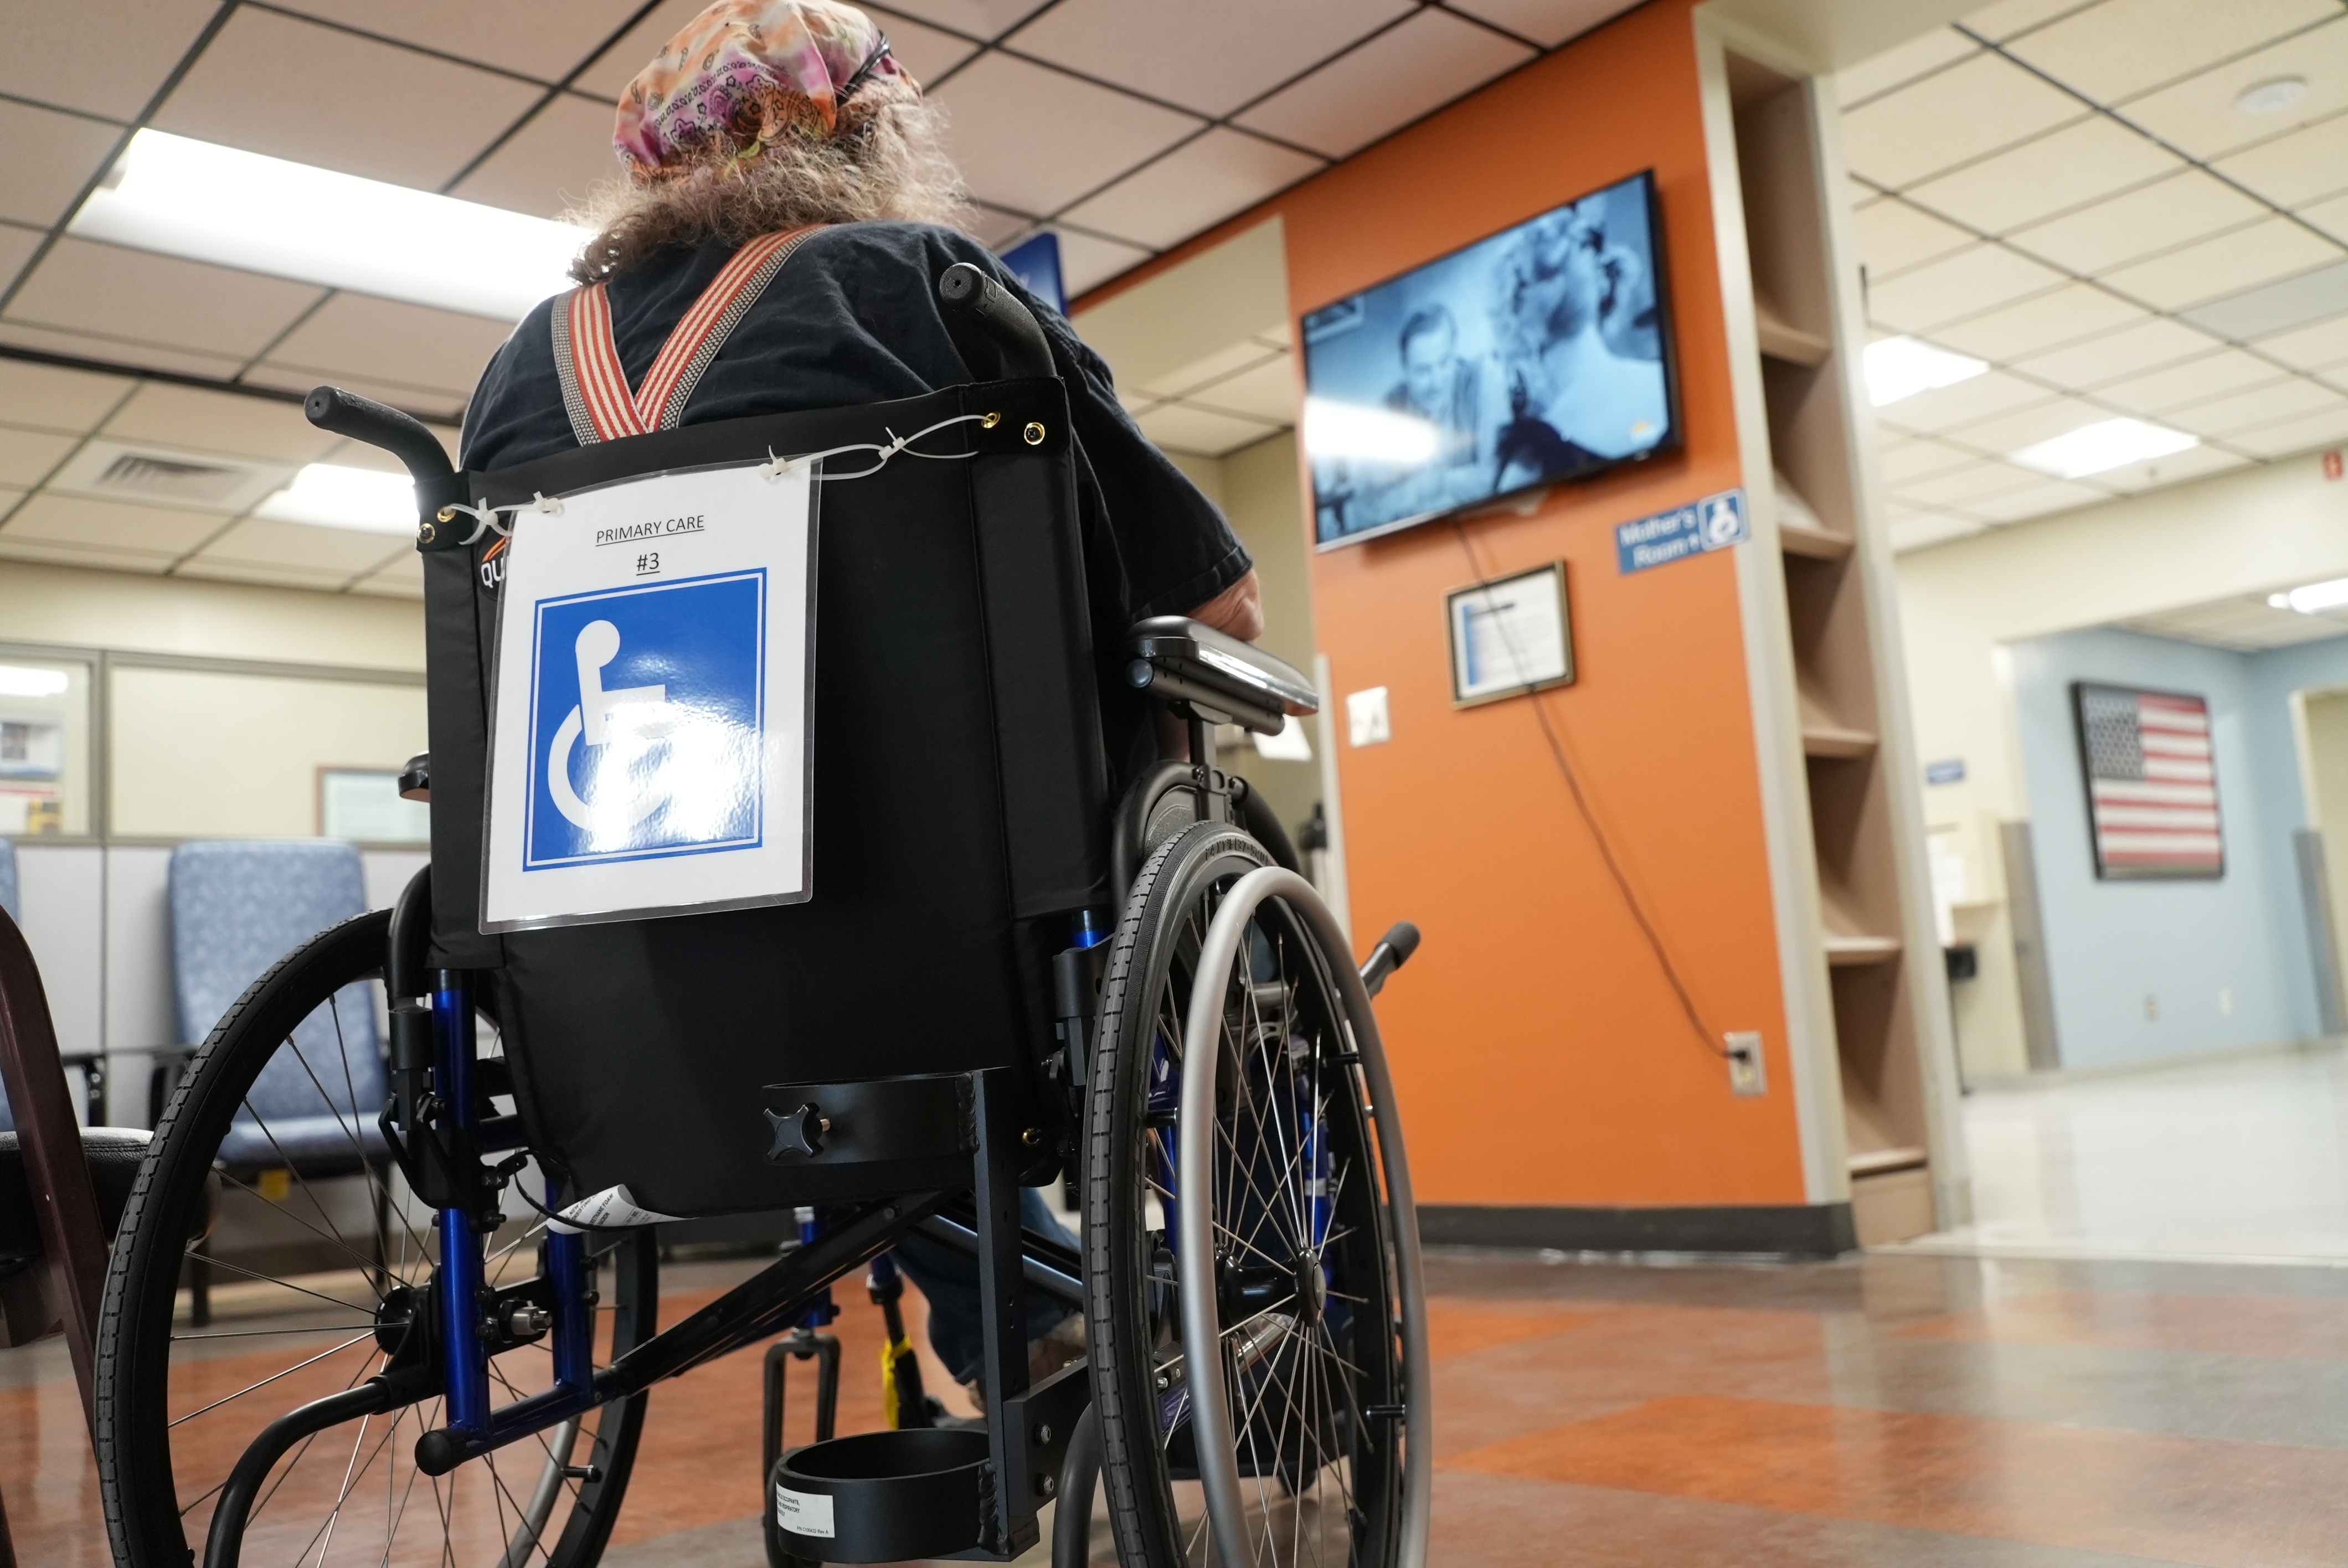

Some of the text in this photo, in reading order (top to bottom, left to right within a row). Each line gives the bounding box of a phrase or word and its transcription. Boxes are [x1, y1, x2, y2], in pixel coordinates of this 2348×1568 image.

[596, 515, 704, 543] PRIMARY CARE
[636, 552, 660, 571] #3
[571, 1198, 591, 1221] ONSISTING
[602, 1193, 613, 1208] FOAM
